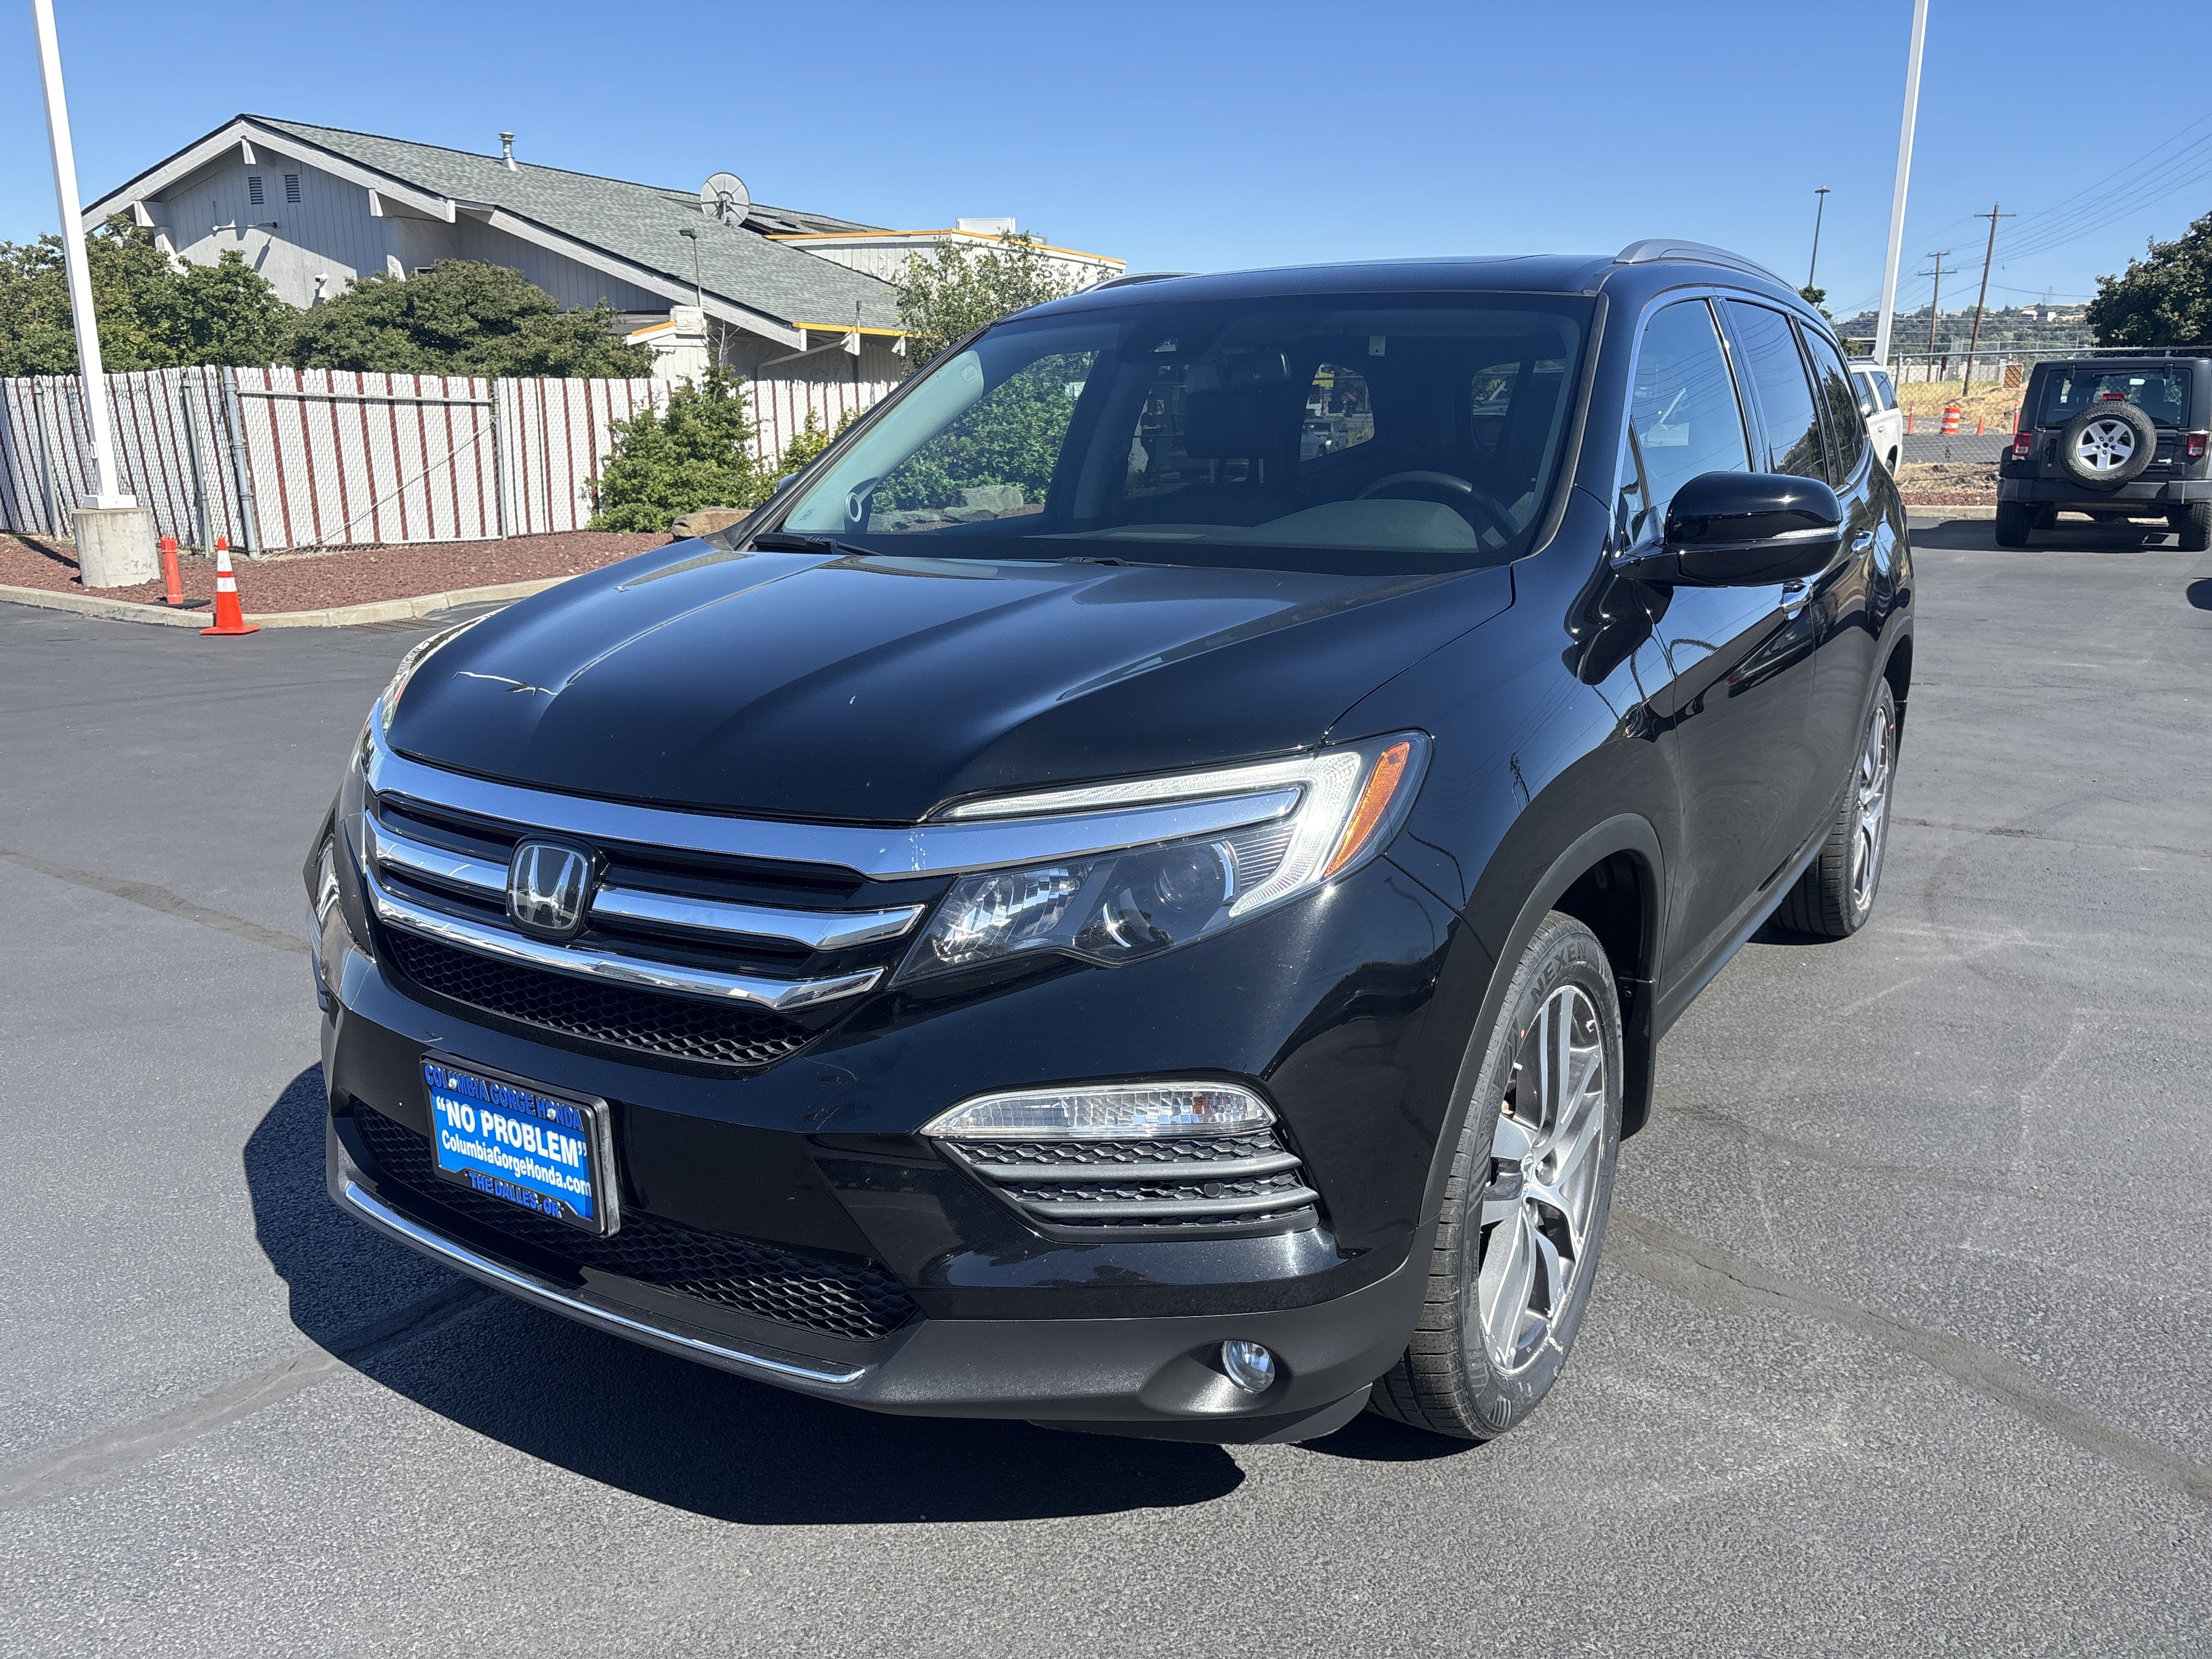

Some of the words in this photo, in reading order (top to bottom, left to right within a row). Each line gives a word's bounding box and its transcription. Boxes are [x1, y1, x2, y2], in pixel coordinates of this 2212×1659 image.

[1530, 941, 1587, 1005] NEXEN
[489, 1084, 536, 1116] GORGE
[442, 1129, 592, 1198] ColumbiaGorgeHonda.com
[469, 1172, 494, 1192] THE
[543, 1198, 563, 1219] OR
